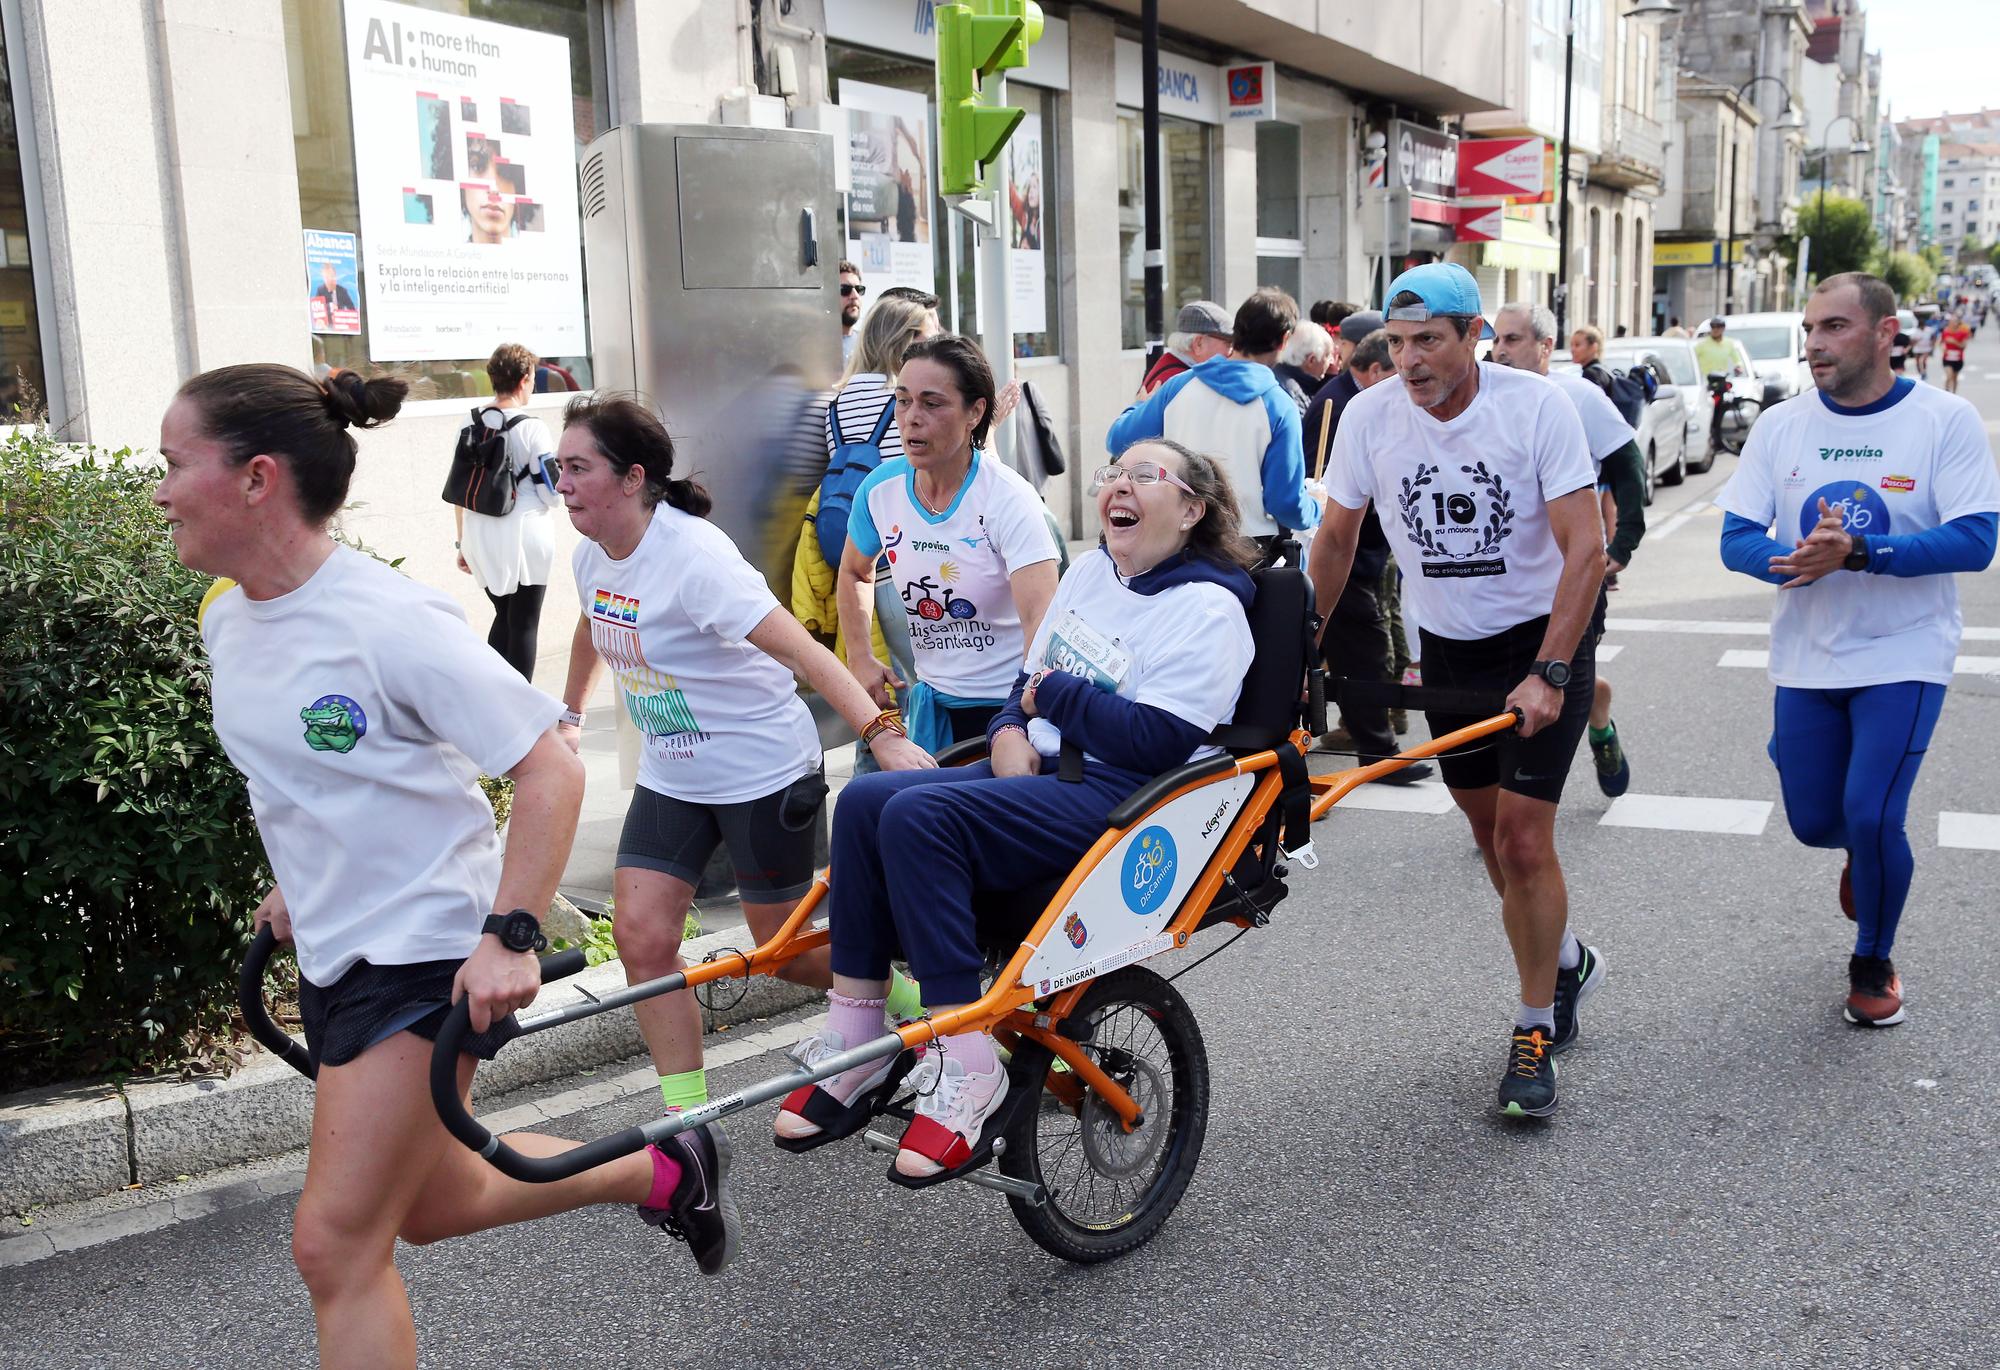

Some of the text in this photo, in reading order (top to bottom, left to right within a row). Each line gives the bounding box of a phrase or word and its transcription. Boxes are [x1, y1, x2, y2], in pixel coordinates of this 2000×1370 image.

[420, 31, 462, 51] more
[465, 34, 500, 58] than
[421, 50, 477, 78] human
[1157, 66, 1198, 103] BANCA
[378, 263, 569, 283] Explora la relación entre las personas
[379, 280, 510, 296] y la inteligencia artificial
[1834, 445, 1883, 461] povisa
[1882, 478, 1913, 489] Pascual
[921, 541, 950, 552] povisa
[923, 632, 995, 652] Santiago
[1140, 860, 1173, 908] DisCamino
[1053, 980, 1064, 989] DE
[1066, 967, 1096, 985] NIGRAN
